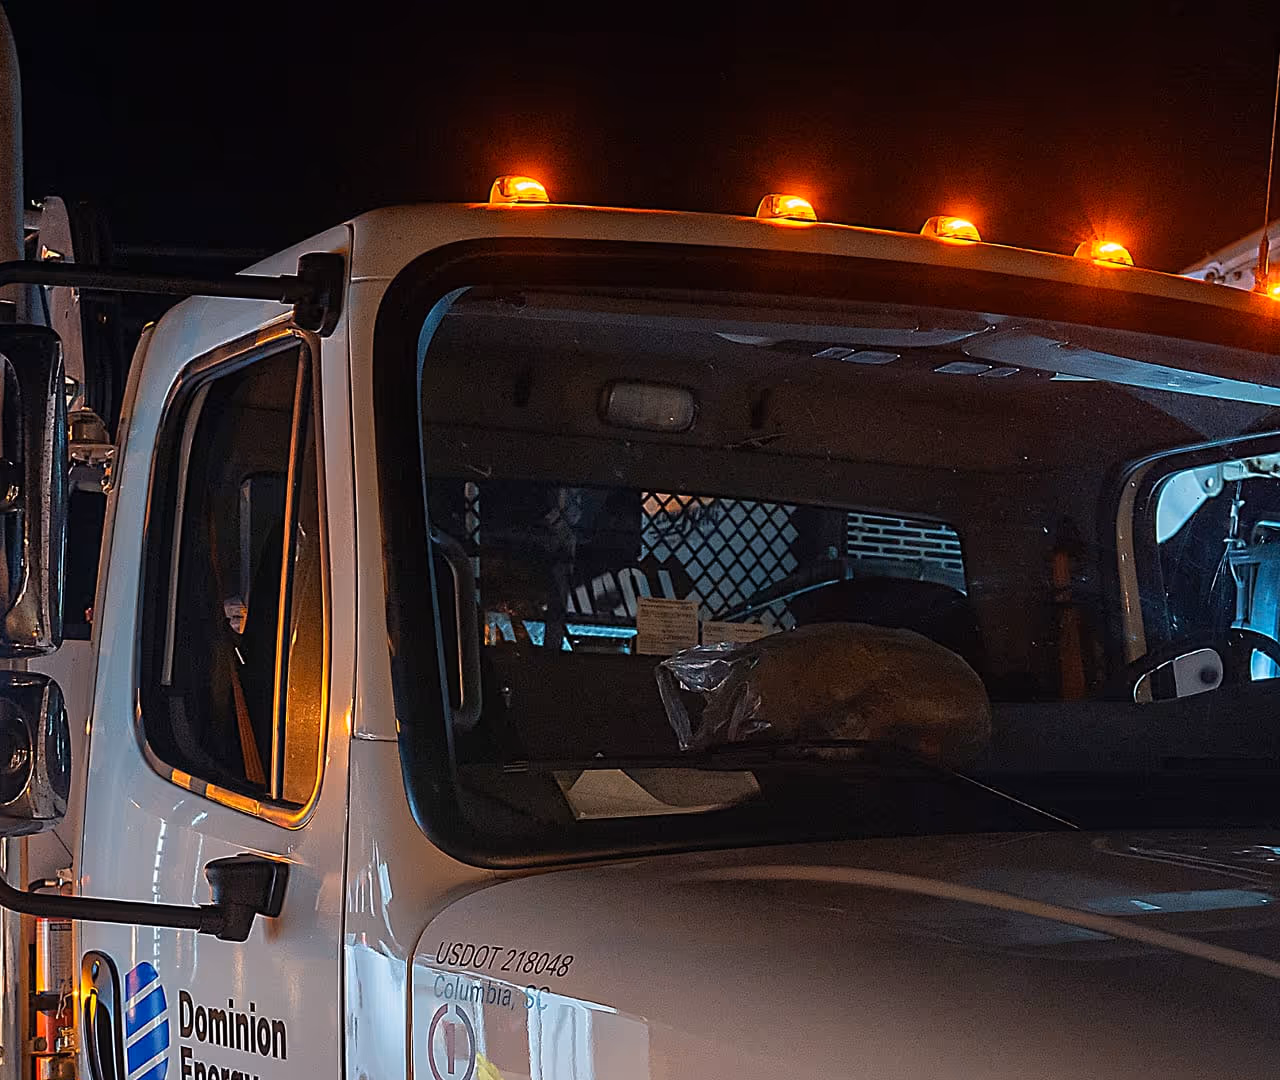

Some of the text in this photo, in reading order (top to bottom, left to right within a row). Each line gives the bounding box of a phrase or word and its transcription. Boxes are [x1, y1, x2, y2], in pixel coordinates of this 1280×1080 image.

[436, 941, 574, 977] USDOT 218048
[433, 974, 551, 1011] Columbia, SC
[179, 989, 287, 1060] Dominion
